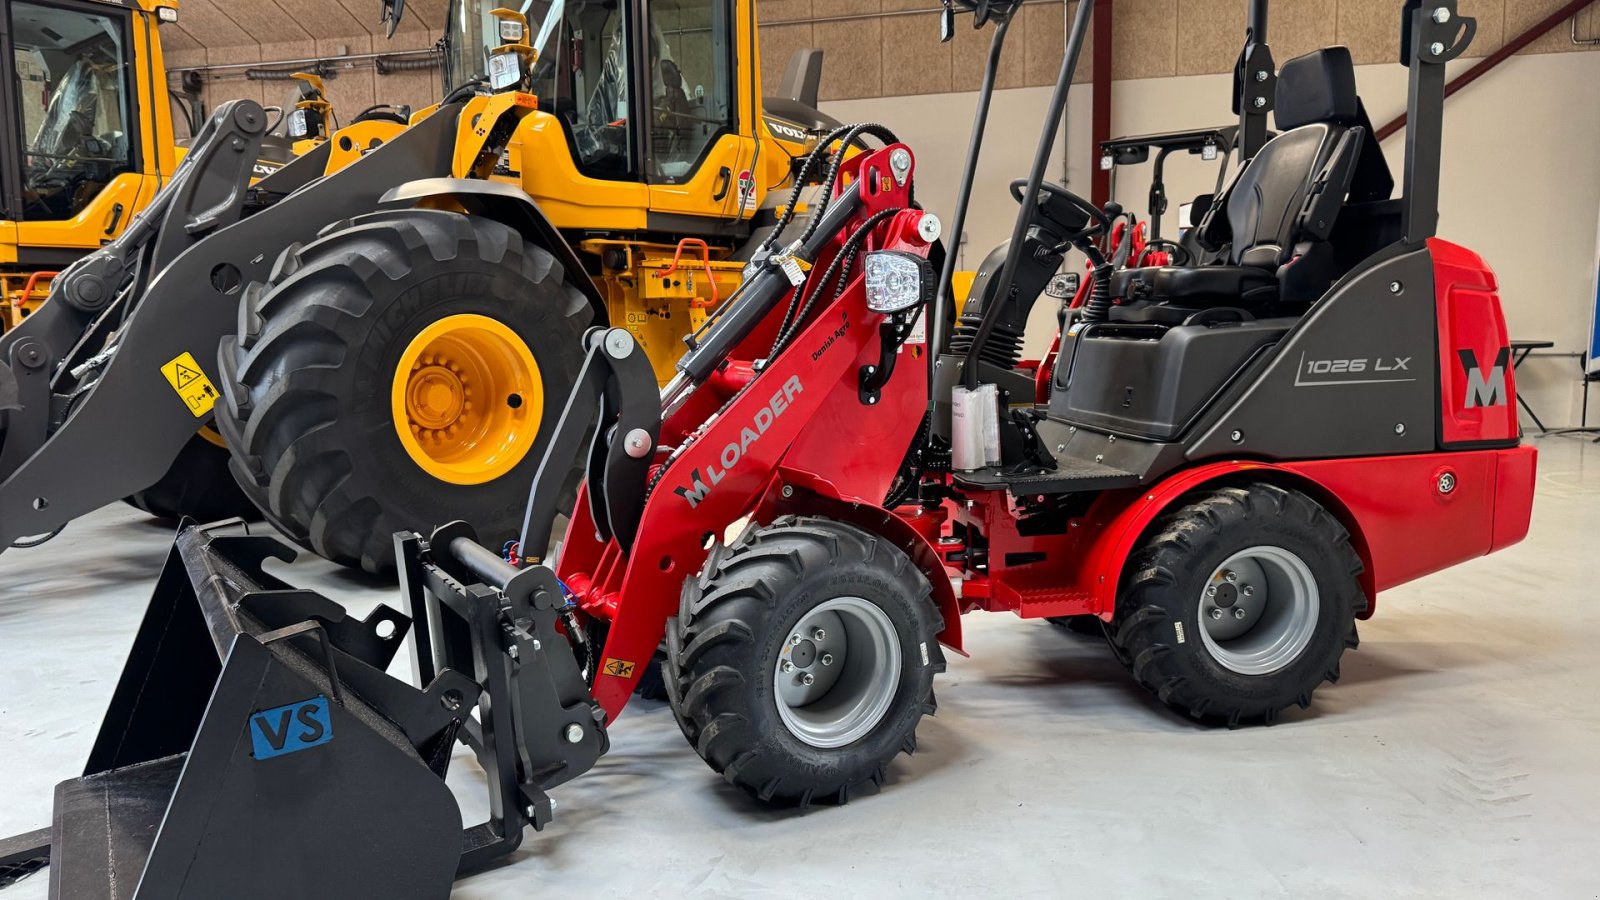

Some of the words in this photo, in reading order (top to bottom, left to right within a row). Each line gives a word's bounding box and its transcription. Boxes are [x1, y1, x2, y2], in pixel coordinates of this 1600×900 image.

[811, 336, 835, 361] Danish
[834, 321, 850, 339] Agro
[1307, 358, 1368, 374] 1026
[1374, 356, 1412, 371] LX
[706, 374, 804, 486] LOADER
[254, 703, 324, 750] VS
